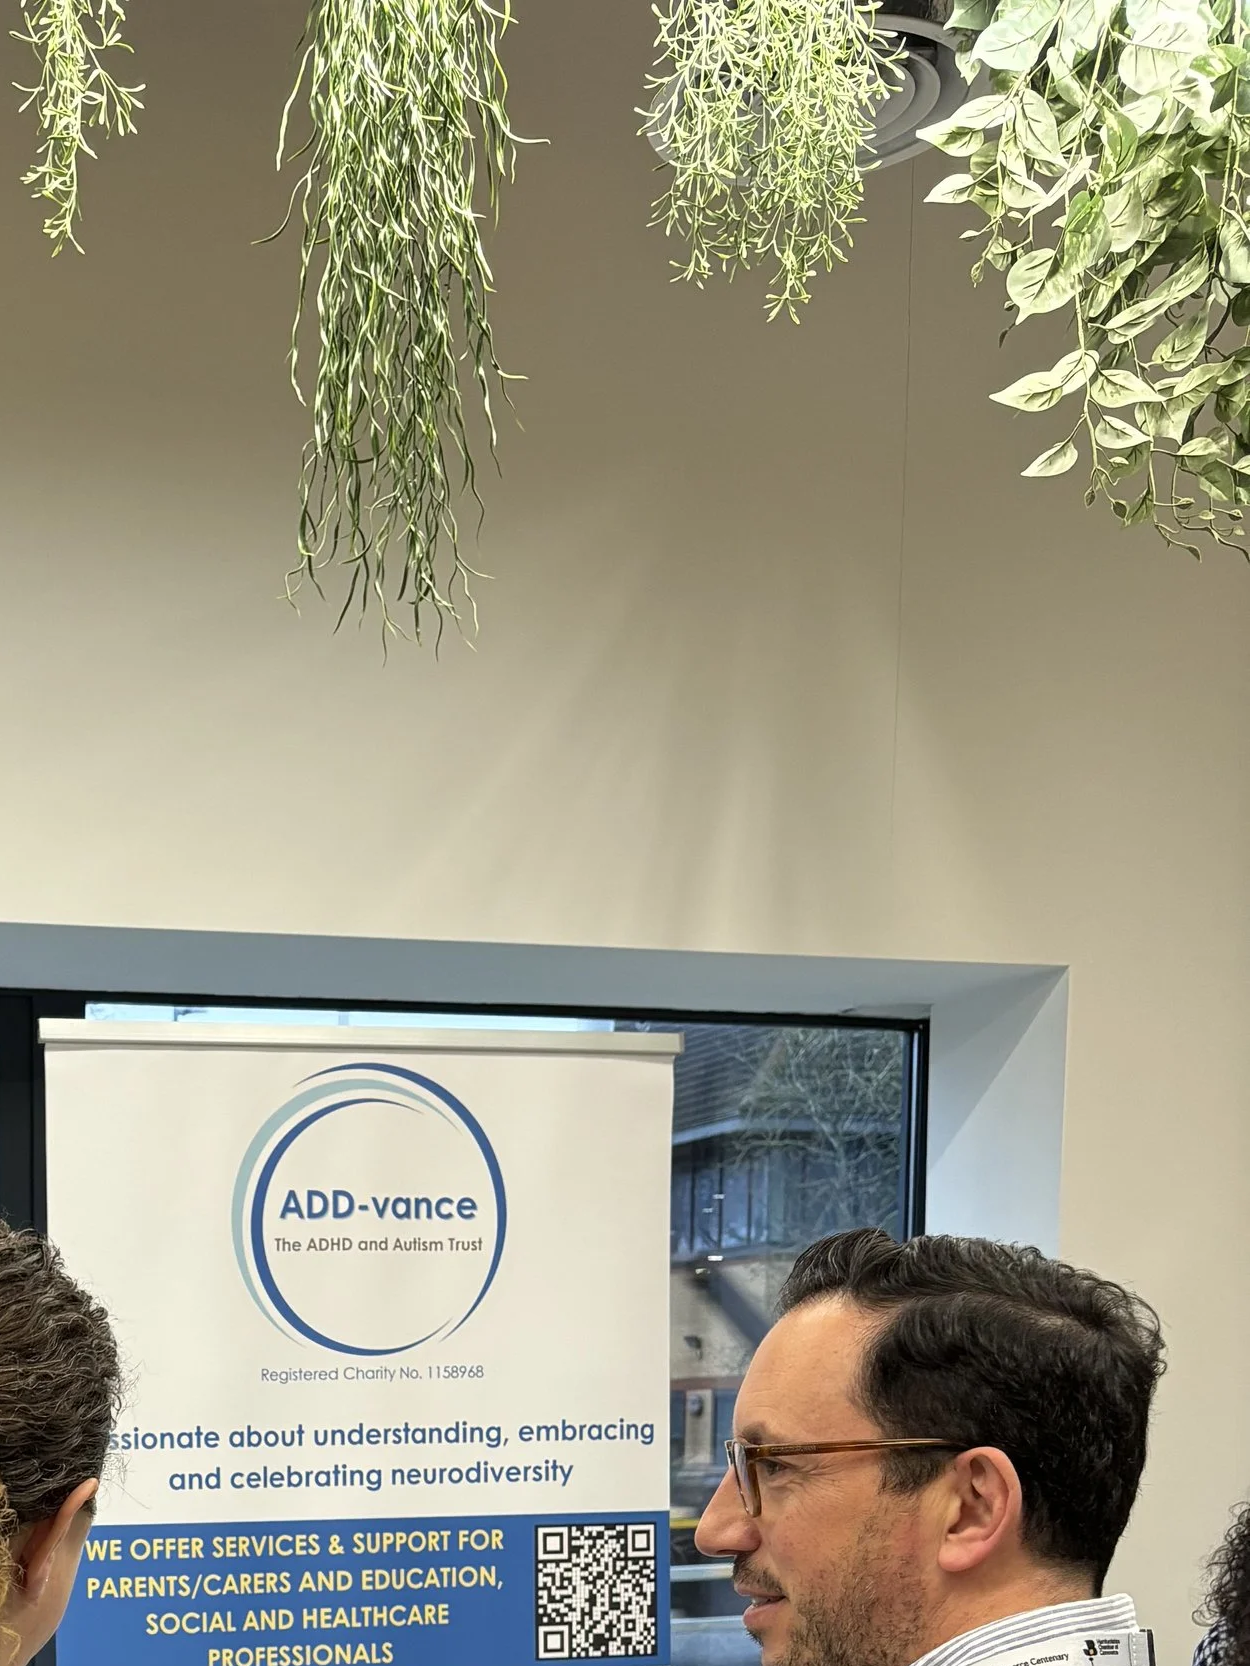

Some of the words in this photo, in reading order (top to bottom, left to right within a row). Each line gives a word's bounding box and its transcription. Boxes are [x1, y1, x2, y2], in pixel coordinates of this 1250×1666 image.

[279, 1189, 478, 1221] ADD-vance
[275, 1238, 301, 1252] The
[307, 1237, 353, 1252] ADHD
[358, 1237, 388, 1252] and
[393, 1237, 443, 1252] Autism
[449, 1237, 483, 1252] Trust
[261, 1368, 338, 1384] Registered
[344, 1366, 396, 1383] Charity
[400, 1366, 422, 1380] No.
[427, 1365, 484, 1380] 1158968
[108, 1426, 220, 1450] ssionate
[229, 1423, 304, 1447] about
[313, 1420, 509, 1449] understanding,
[518, 1417, 654, 1444] embracing
[169, 1467, 220, 1491] and
[230, 1462, 382, 1494] celebrating
[391, 1460, 574, 1486] neurodiversity
[86, 1539, 122, 1561] WE
[130, 1536, 204, 1561] OFFER
[212, 1533, 320, 1558] SERVICES
[328, 1533, 345, 1555] &
[353, 1530, 451, 1555] SUPPORT
[457, 1528, 504, 1551] FOR
[86, 1571, 292, 1600] PARENTS/CARERS
[300, 1569, 353, 1593] AND
[361, 1565, 504, 1591] EDUCATION,
[146, 1611, 236, 1635] SOCIAL
[243, 1609, 294, 1632] AND
[302, 1603, 450, 1629] HEALTHCARE
[1030, 1653, 1069, 1666] Centenary
